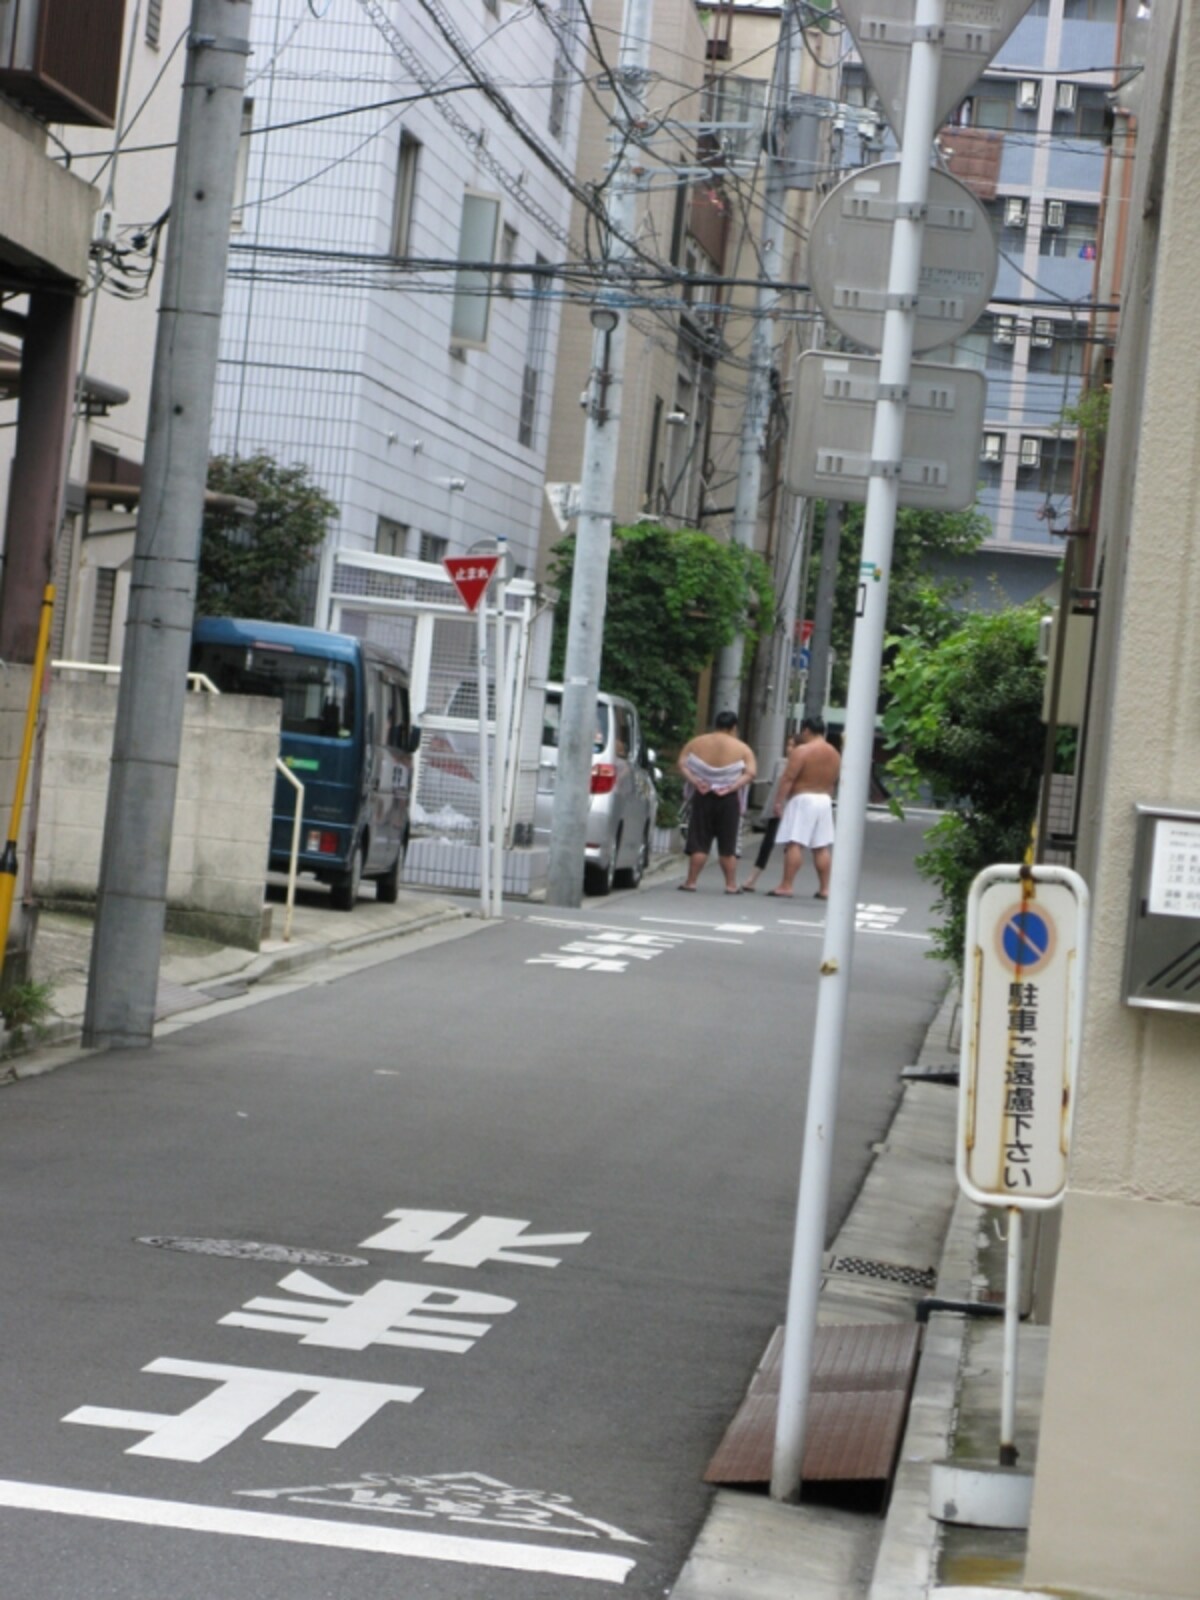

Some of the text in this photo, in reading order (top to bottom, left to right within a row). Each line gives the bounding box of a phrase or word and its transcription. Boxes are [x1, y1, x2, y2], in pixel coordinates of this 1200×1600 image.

[455, 566, 489, 581] 止まれ
[1004, 982, 1039, 1188] 駐車ご遠慮下さい
[60, 1208, 591, 1463] 止まれ
